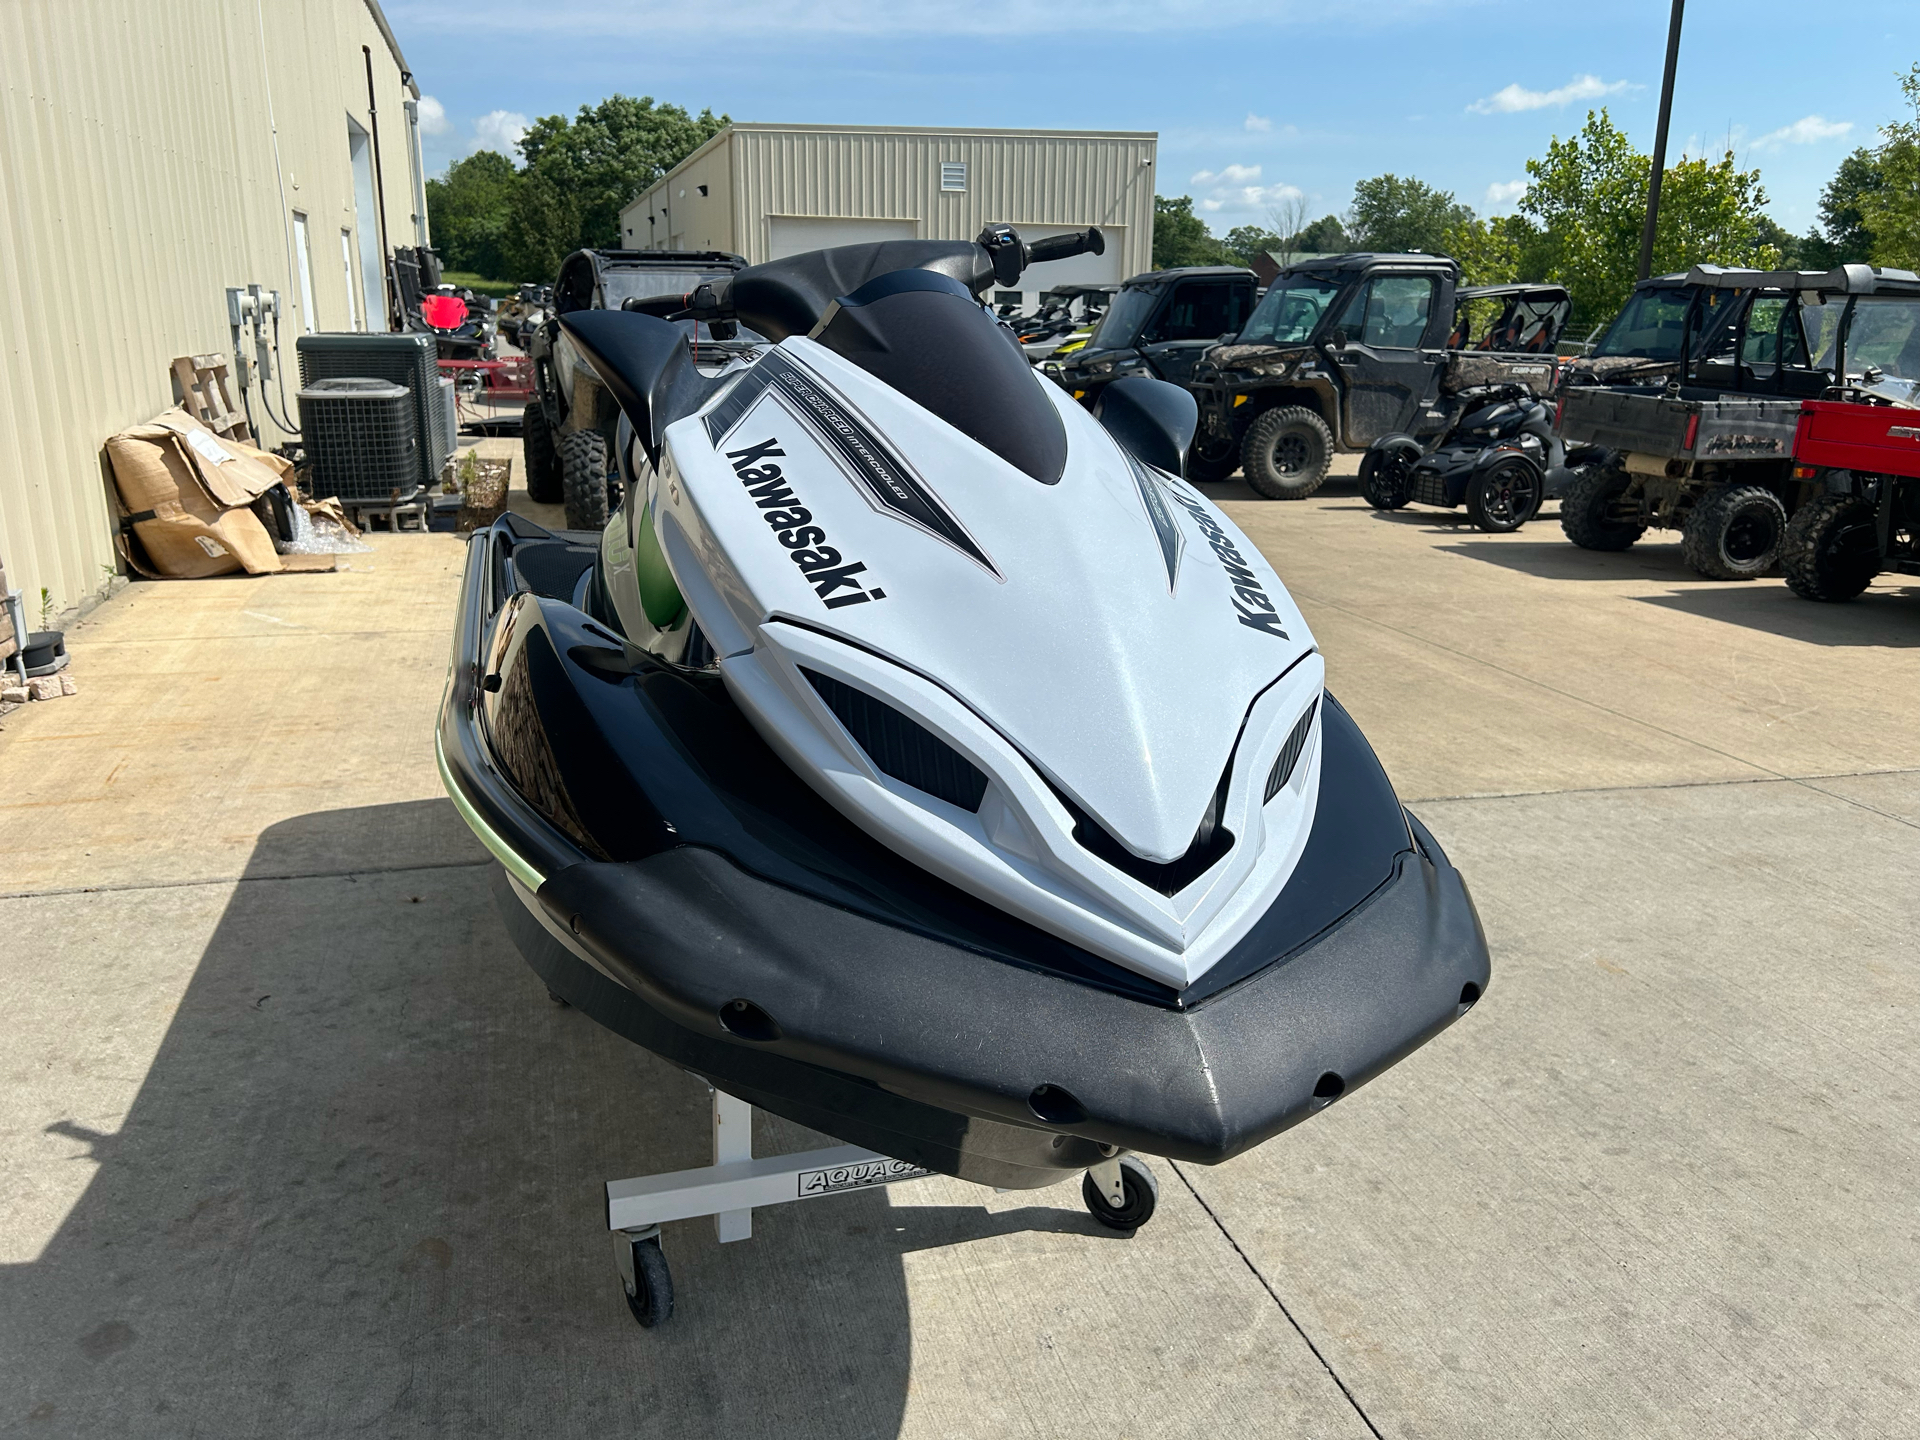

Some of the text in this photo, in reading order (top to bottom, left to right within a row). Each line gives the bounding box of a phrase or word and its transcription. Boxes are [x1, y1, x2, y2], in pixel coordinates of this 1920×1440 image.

[780, 371, 908, 500] SUPERCHARGED INTERCOOLED
[725, 437, 887, 610] Kawasaki
